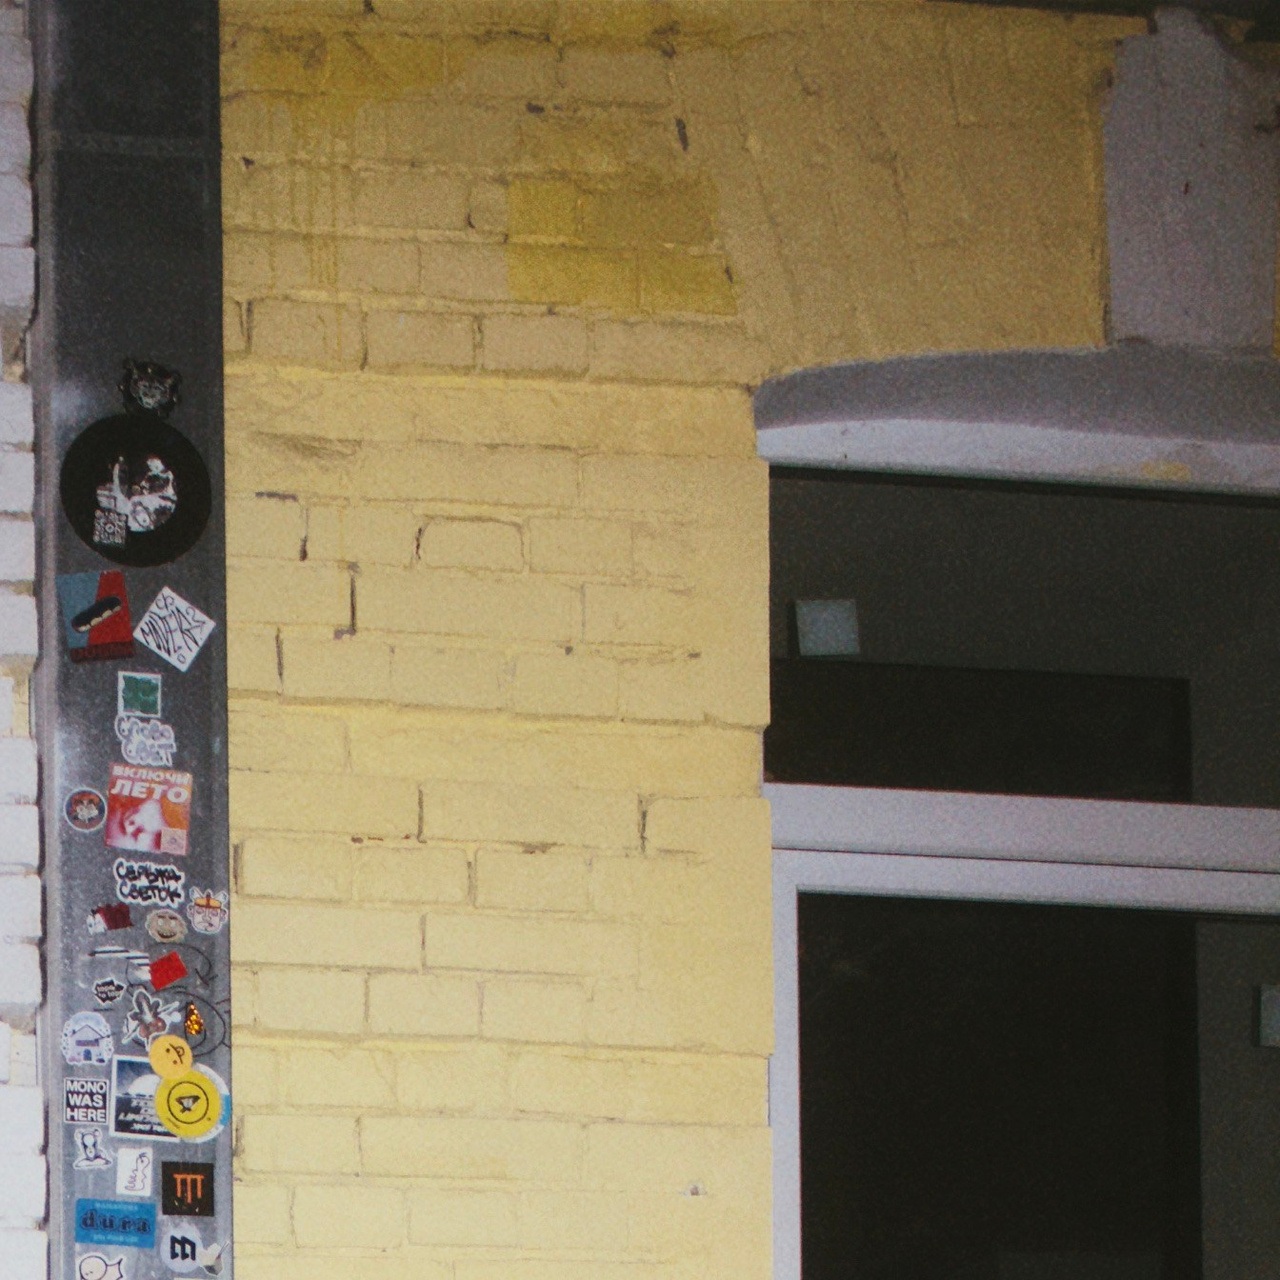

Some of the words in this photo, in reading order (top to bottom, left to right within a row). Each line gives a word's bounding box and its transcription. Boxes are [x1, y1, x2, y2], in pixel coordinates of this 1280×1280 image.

[112, 765, 191, 785] ВКЛЮЧИ
[110, 778, 188, 803] ЛЕТО
[66, 1080, 107, 1094] MONO
[68, 1094, 104, 1108] WAS
[66, 1108, 106, 1122] HERE
[81, 1209, 152, 1234] dura
